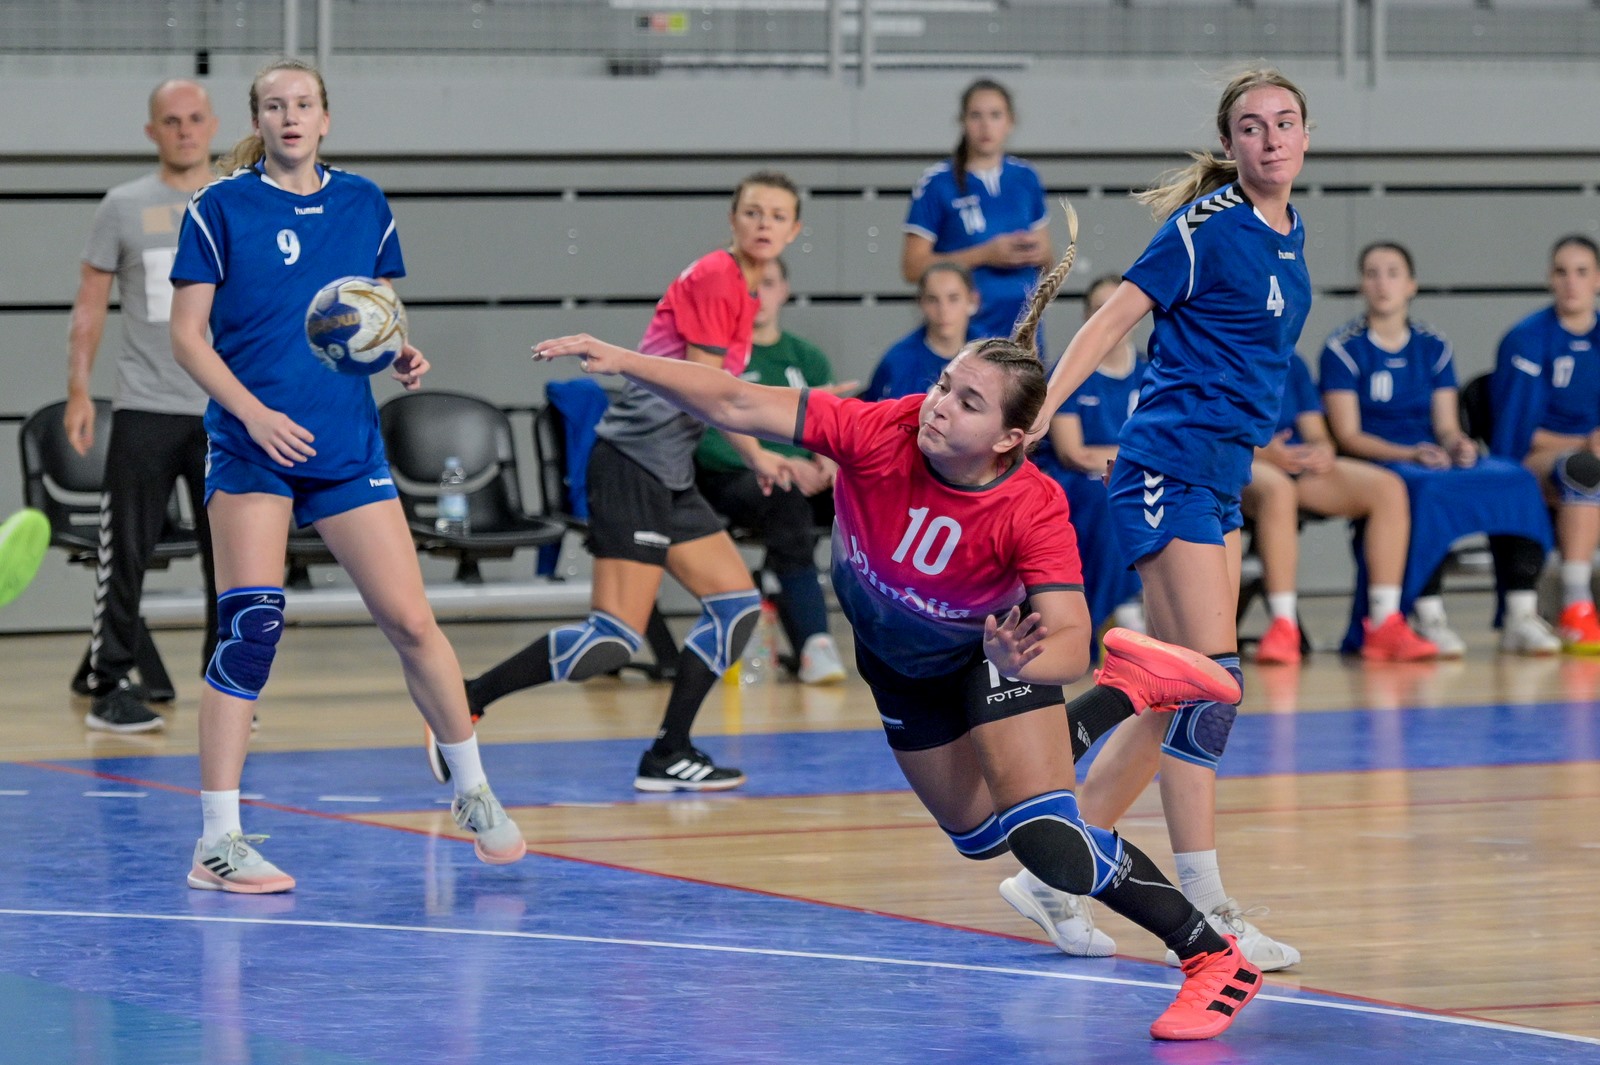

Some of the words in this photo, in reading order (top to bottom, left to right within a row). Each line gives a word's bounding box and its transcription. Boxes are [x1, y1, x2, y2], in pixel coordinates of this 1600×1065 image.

[276, 228, 301, 266] 9
[1266, 275, 1285, 317] 4
[891, 506, 962, 576] 10
[986, 684, 1033, 705] FOTEX
